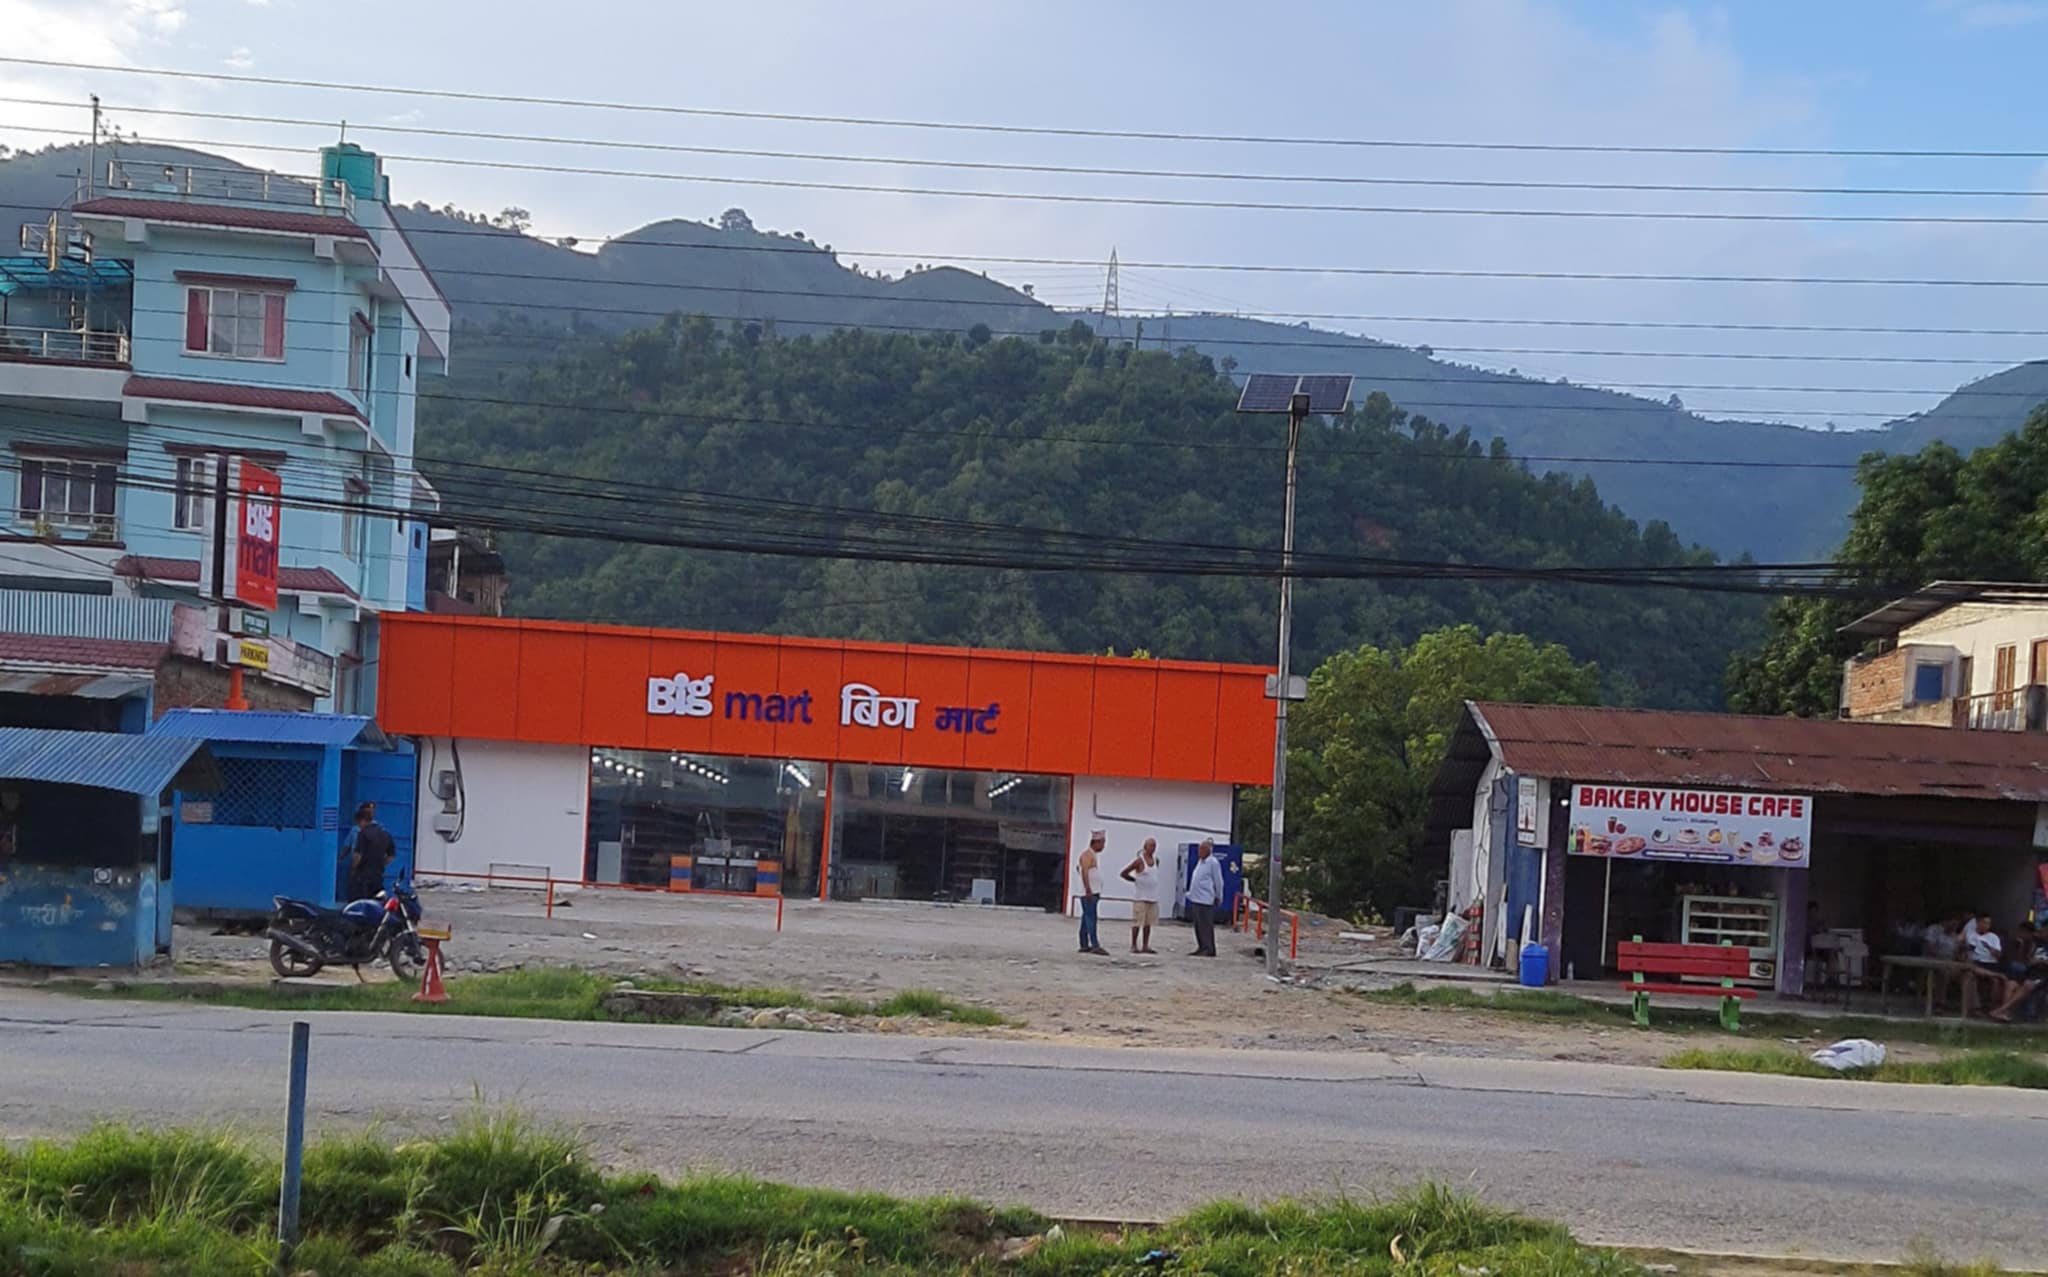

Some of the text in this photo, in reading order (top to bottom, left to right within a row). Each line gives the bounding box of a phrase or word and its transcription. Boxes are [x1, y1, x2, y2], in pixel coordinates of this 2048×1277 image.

[724, 689, 812, 725] mart
[841, 682, 1001, 735] बिग मार्ट
[1579, 786, 1804, 819] BAKERY HOUSE CAFE
